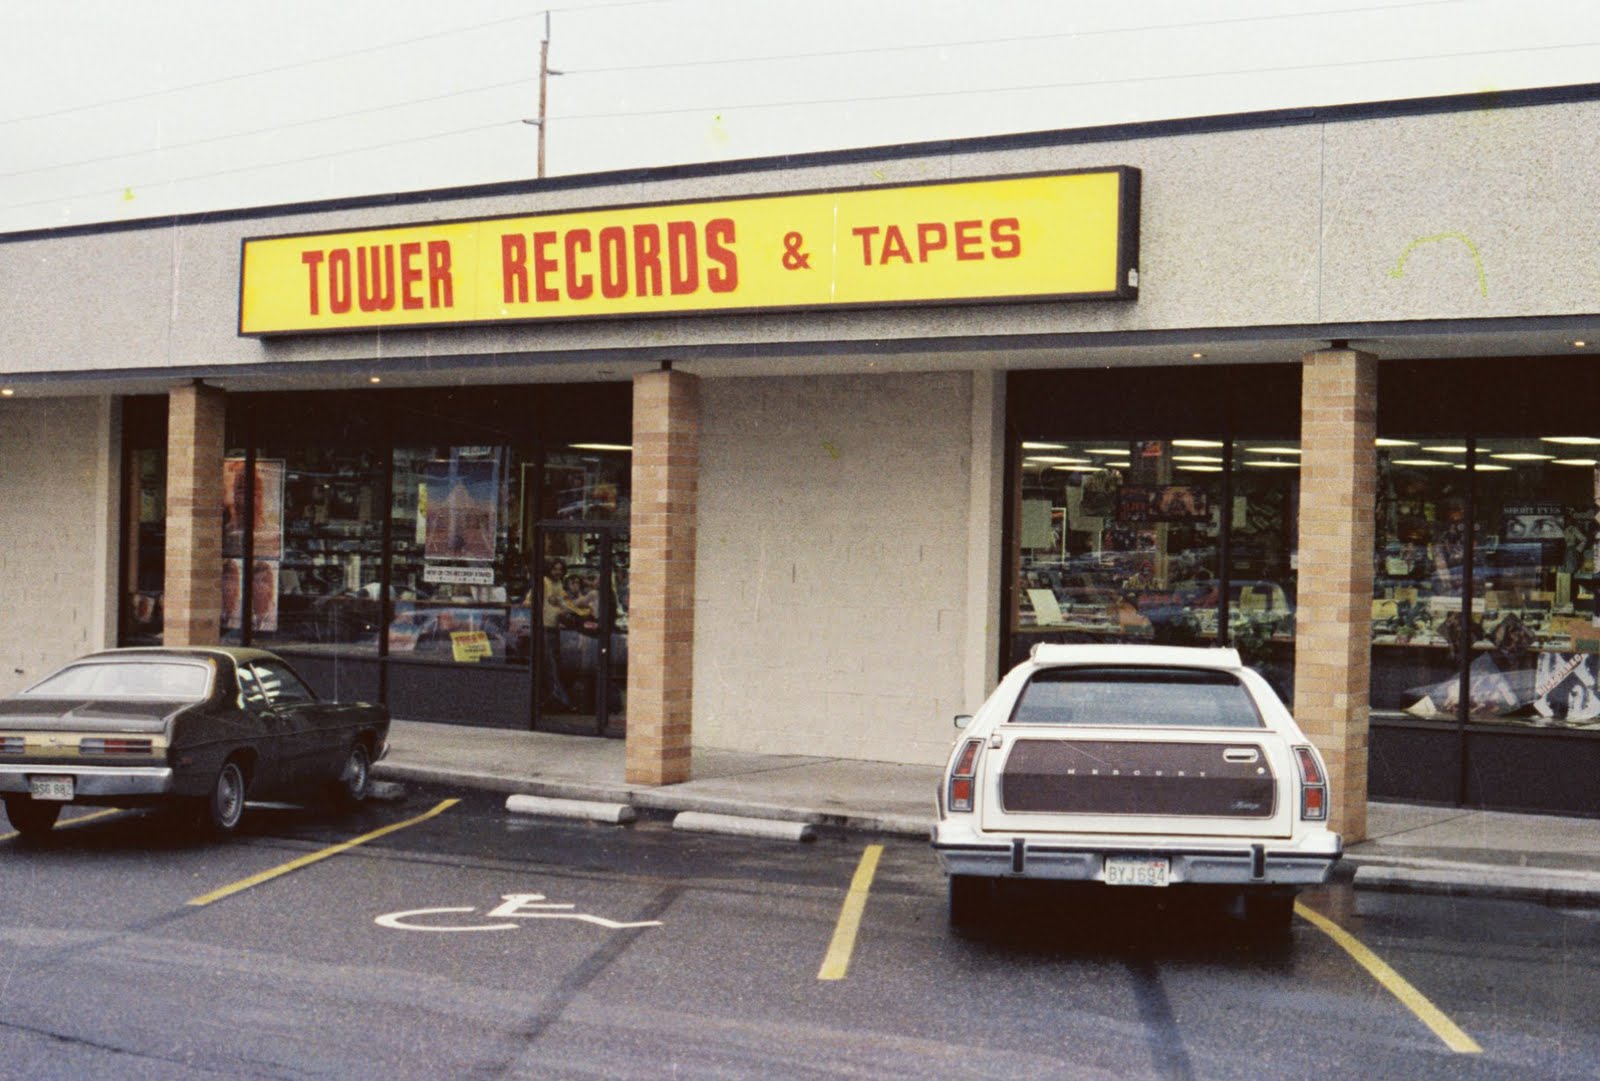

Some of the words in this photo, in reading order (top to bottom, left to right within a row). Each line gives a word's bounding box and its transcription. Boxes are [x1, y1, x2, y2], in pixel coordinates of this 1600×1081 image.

[302, 240, 454, 315] TOWER
[501, 218, 738, 303] RECORDS
[782, 231, 811, 271] &
[852, 218, 1021, 266] TAPES
[1108, 865, 1165, 882] BYJ694
